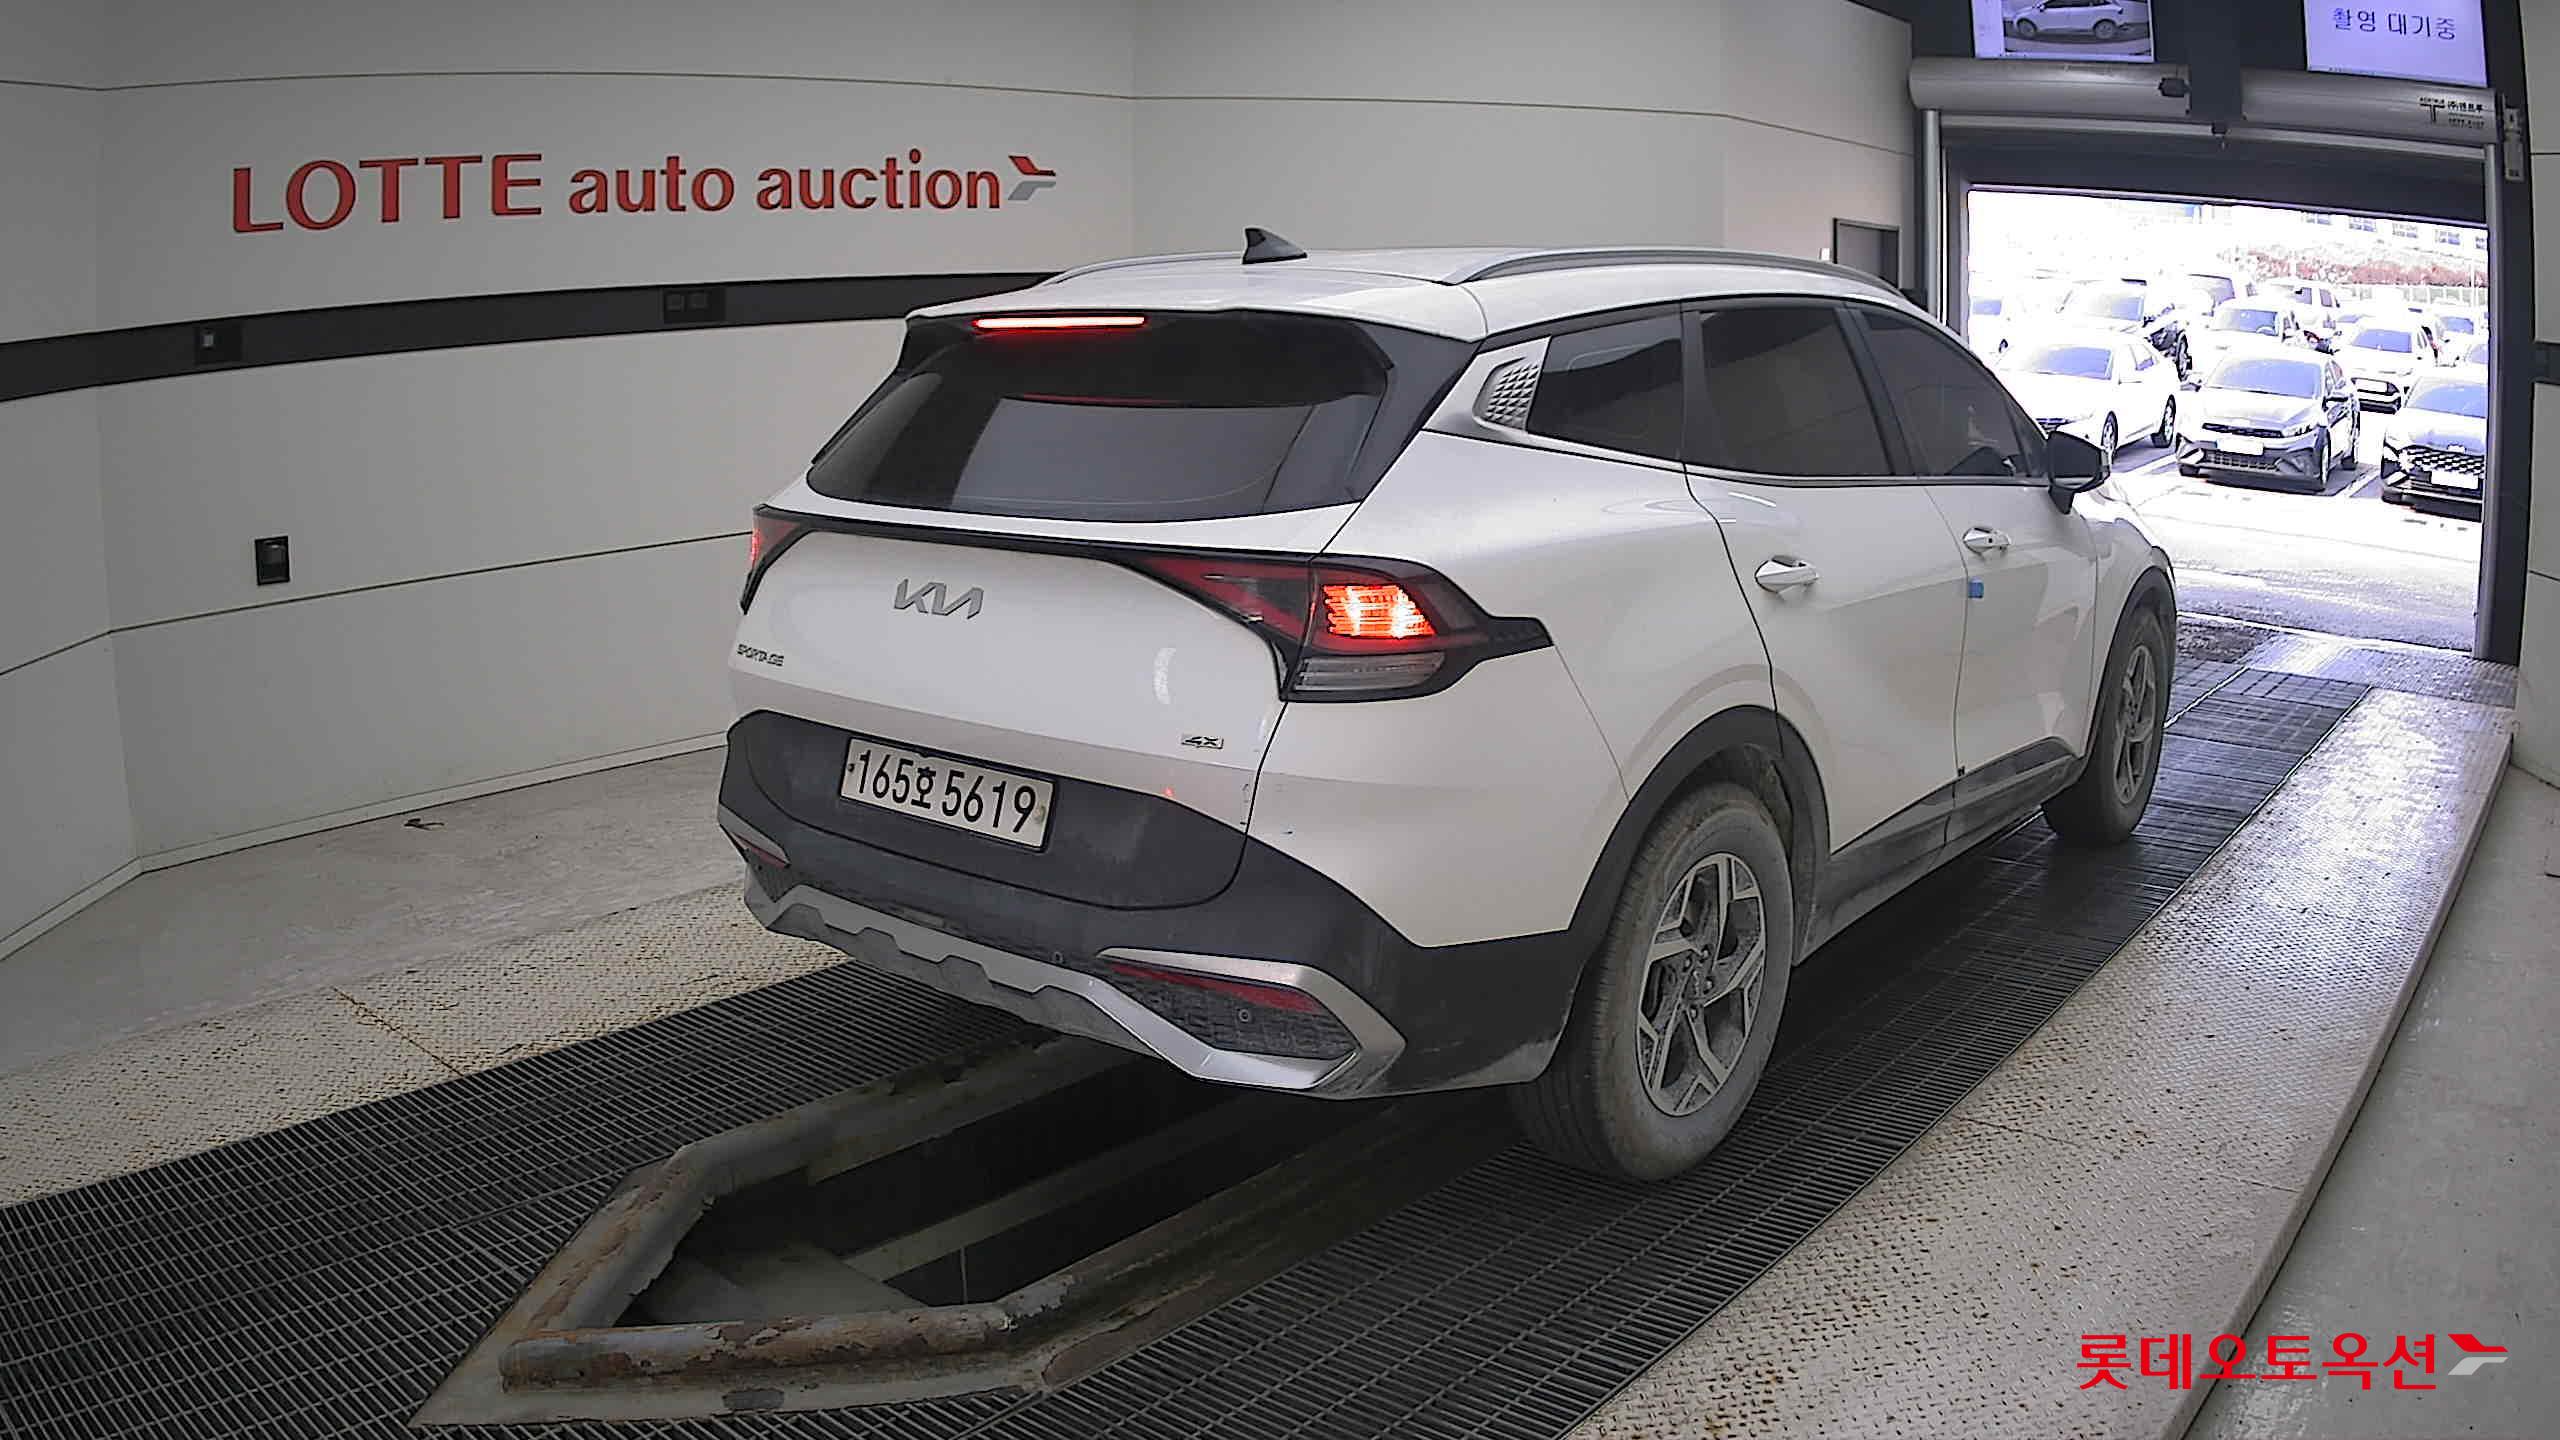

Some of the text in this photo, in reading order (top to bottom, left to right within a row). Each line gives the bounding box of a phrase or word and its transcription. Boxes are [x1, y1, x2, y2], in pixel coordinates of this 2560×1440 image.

[2333, 7, 2456, 41] 촬영 대기중
[233, 149, 1002, 232] LOTTE auto auction
[858, 749, 1037, 833] 165호 5619
